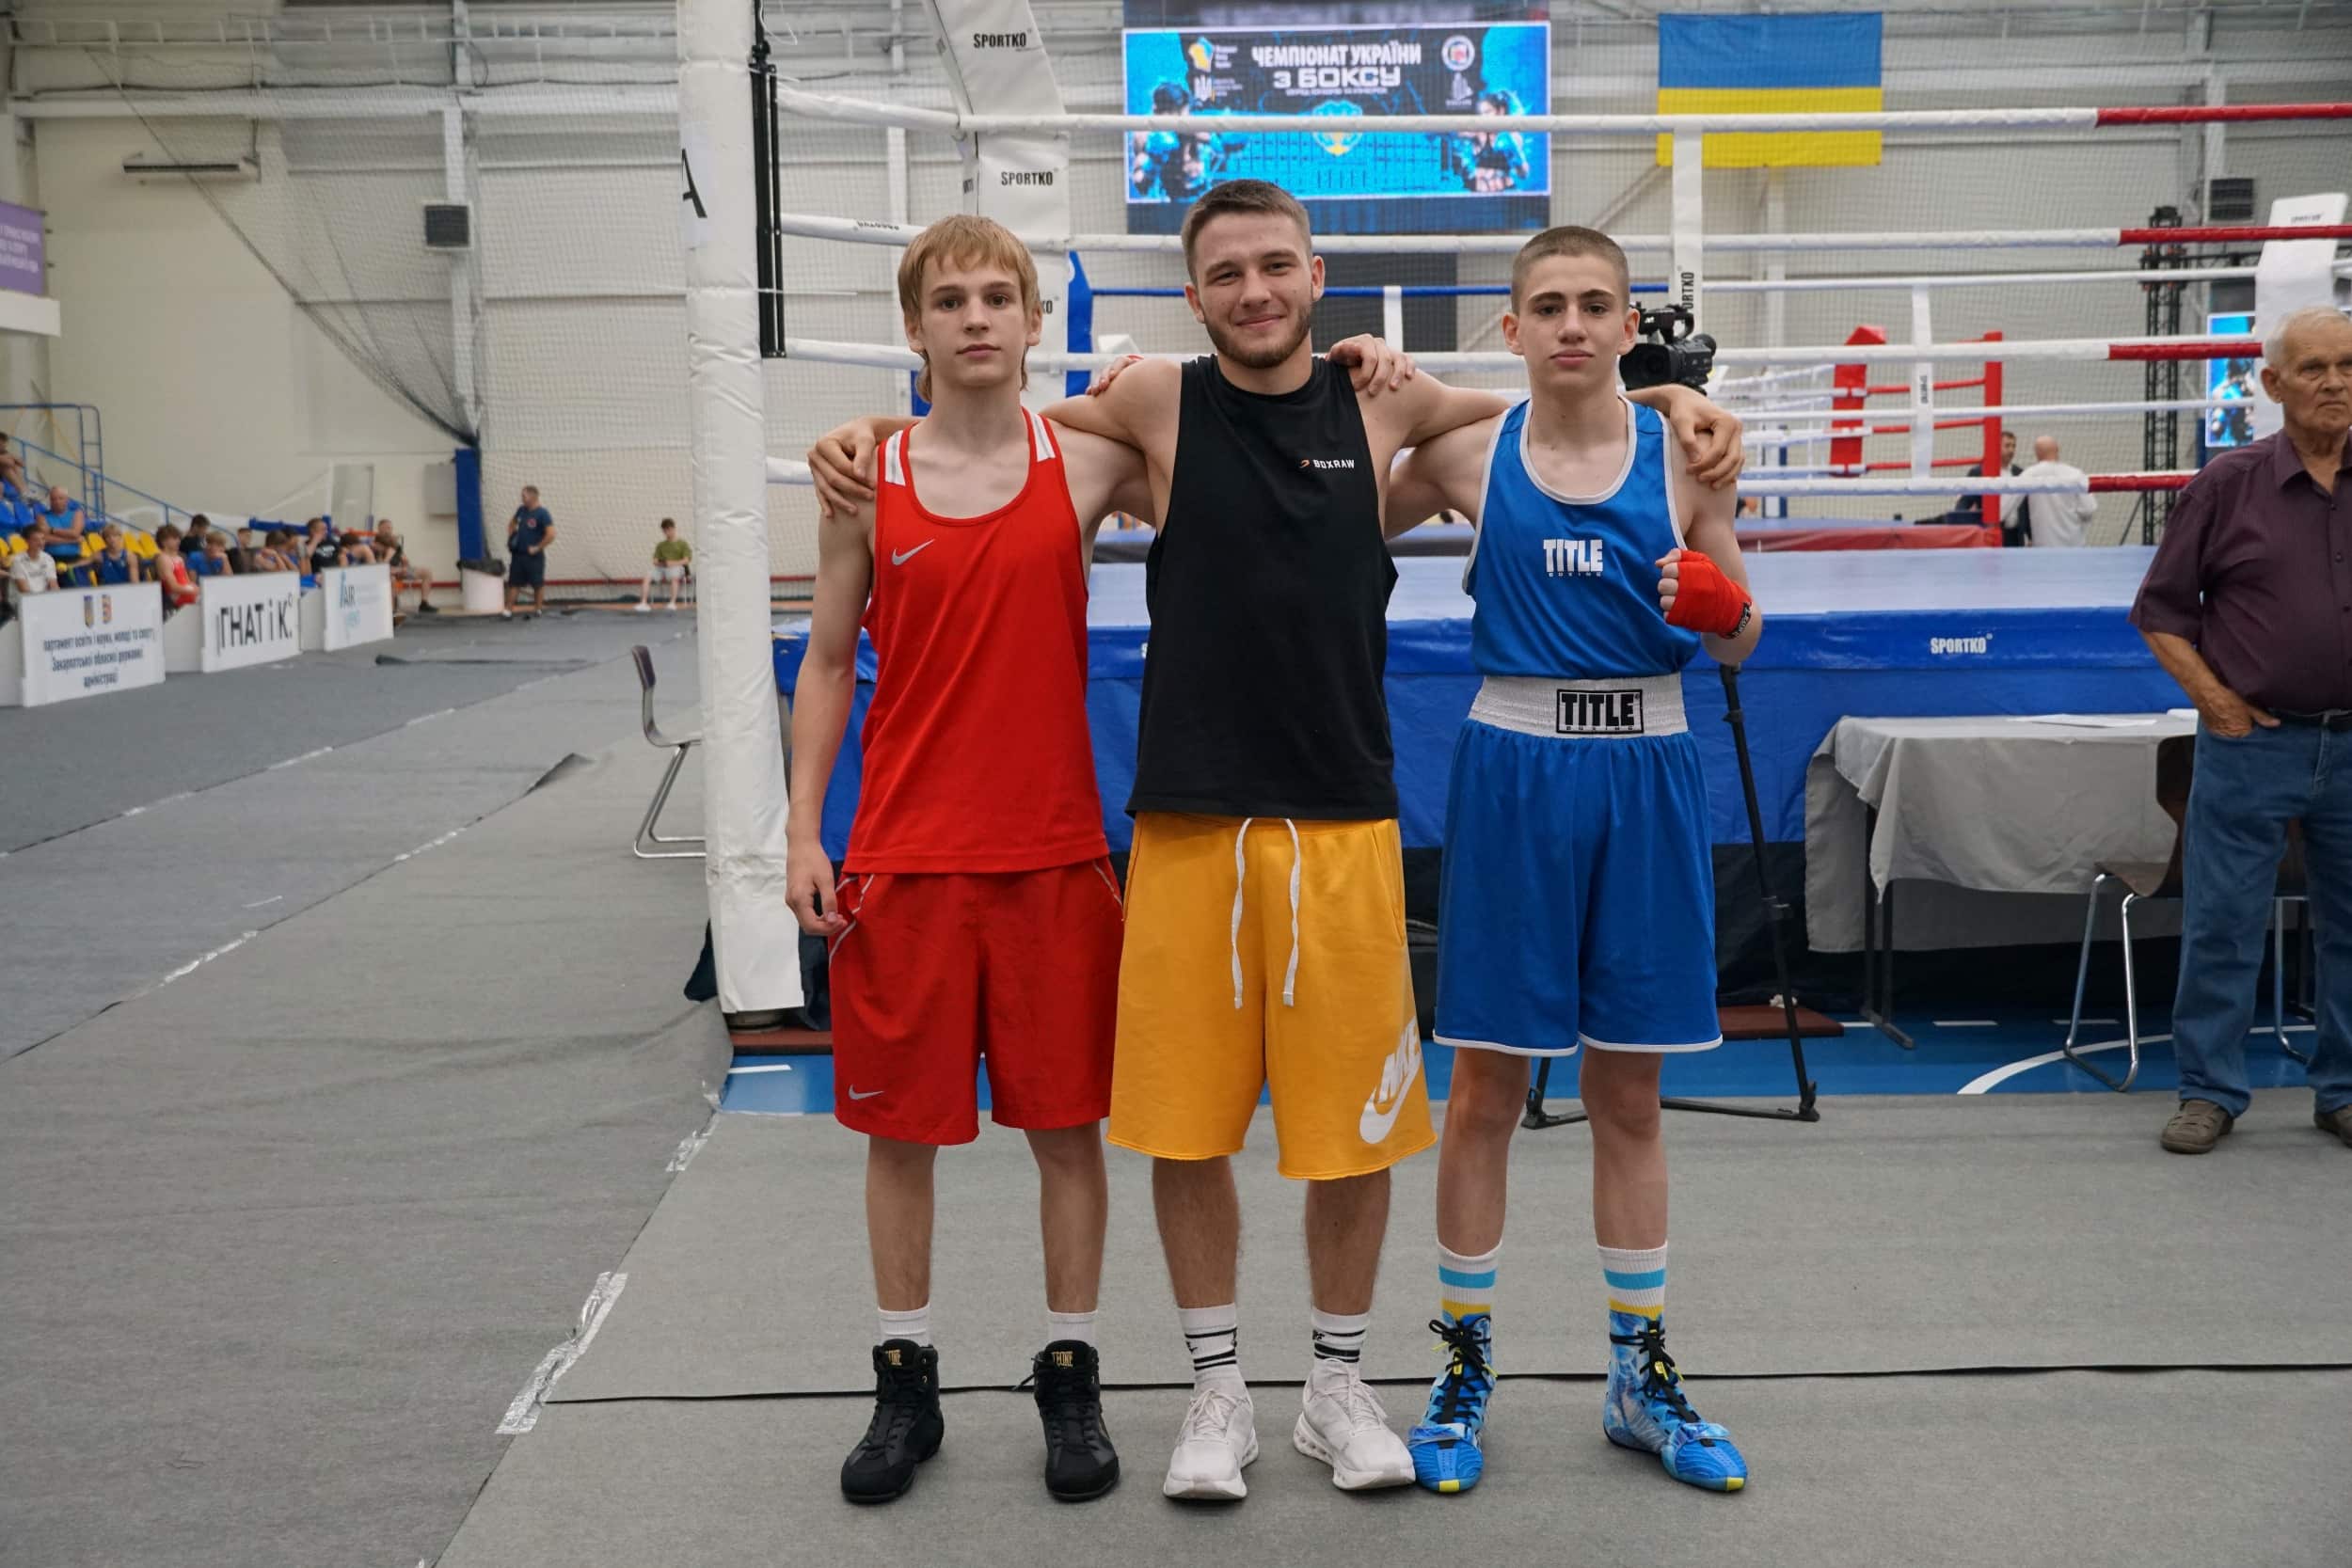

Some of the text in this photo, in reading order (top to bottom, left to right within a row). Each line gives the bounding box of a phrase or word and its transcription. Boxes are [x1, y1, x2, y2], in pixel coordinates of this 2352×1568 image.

[973, 31, 1027, 49] SPORTKO
[1251, 45, 1348, 68] ЧЕМПІОНАТ
[1349, 40, 1422, 66] УКРАЇНИ
[1297, 66, 1401, 88] БОКСУ
[1001, 170, 1054, 186] SPORTKO
[1312, 458, 1355, 469] BOXRAW
[1543, 538, 1604, 573] TITLE
[1930, 637, 1987, 655] SPORTKO
[1561, 693, 1635, 726] TITLE
